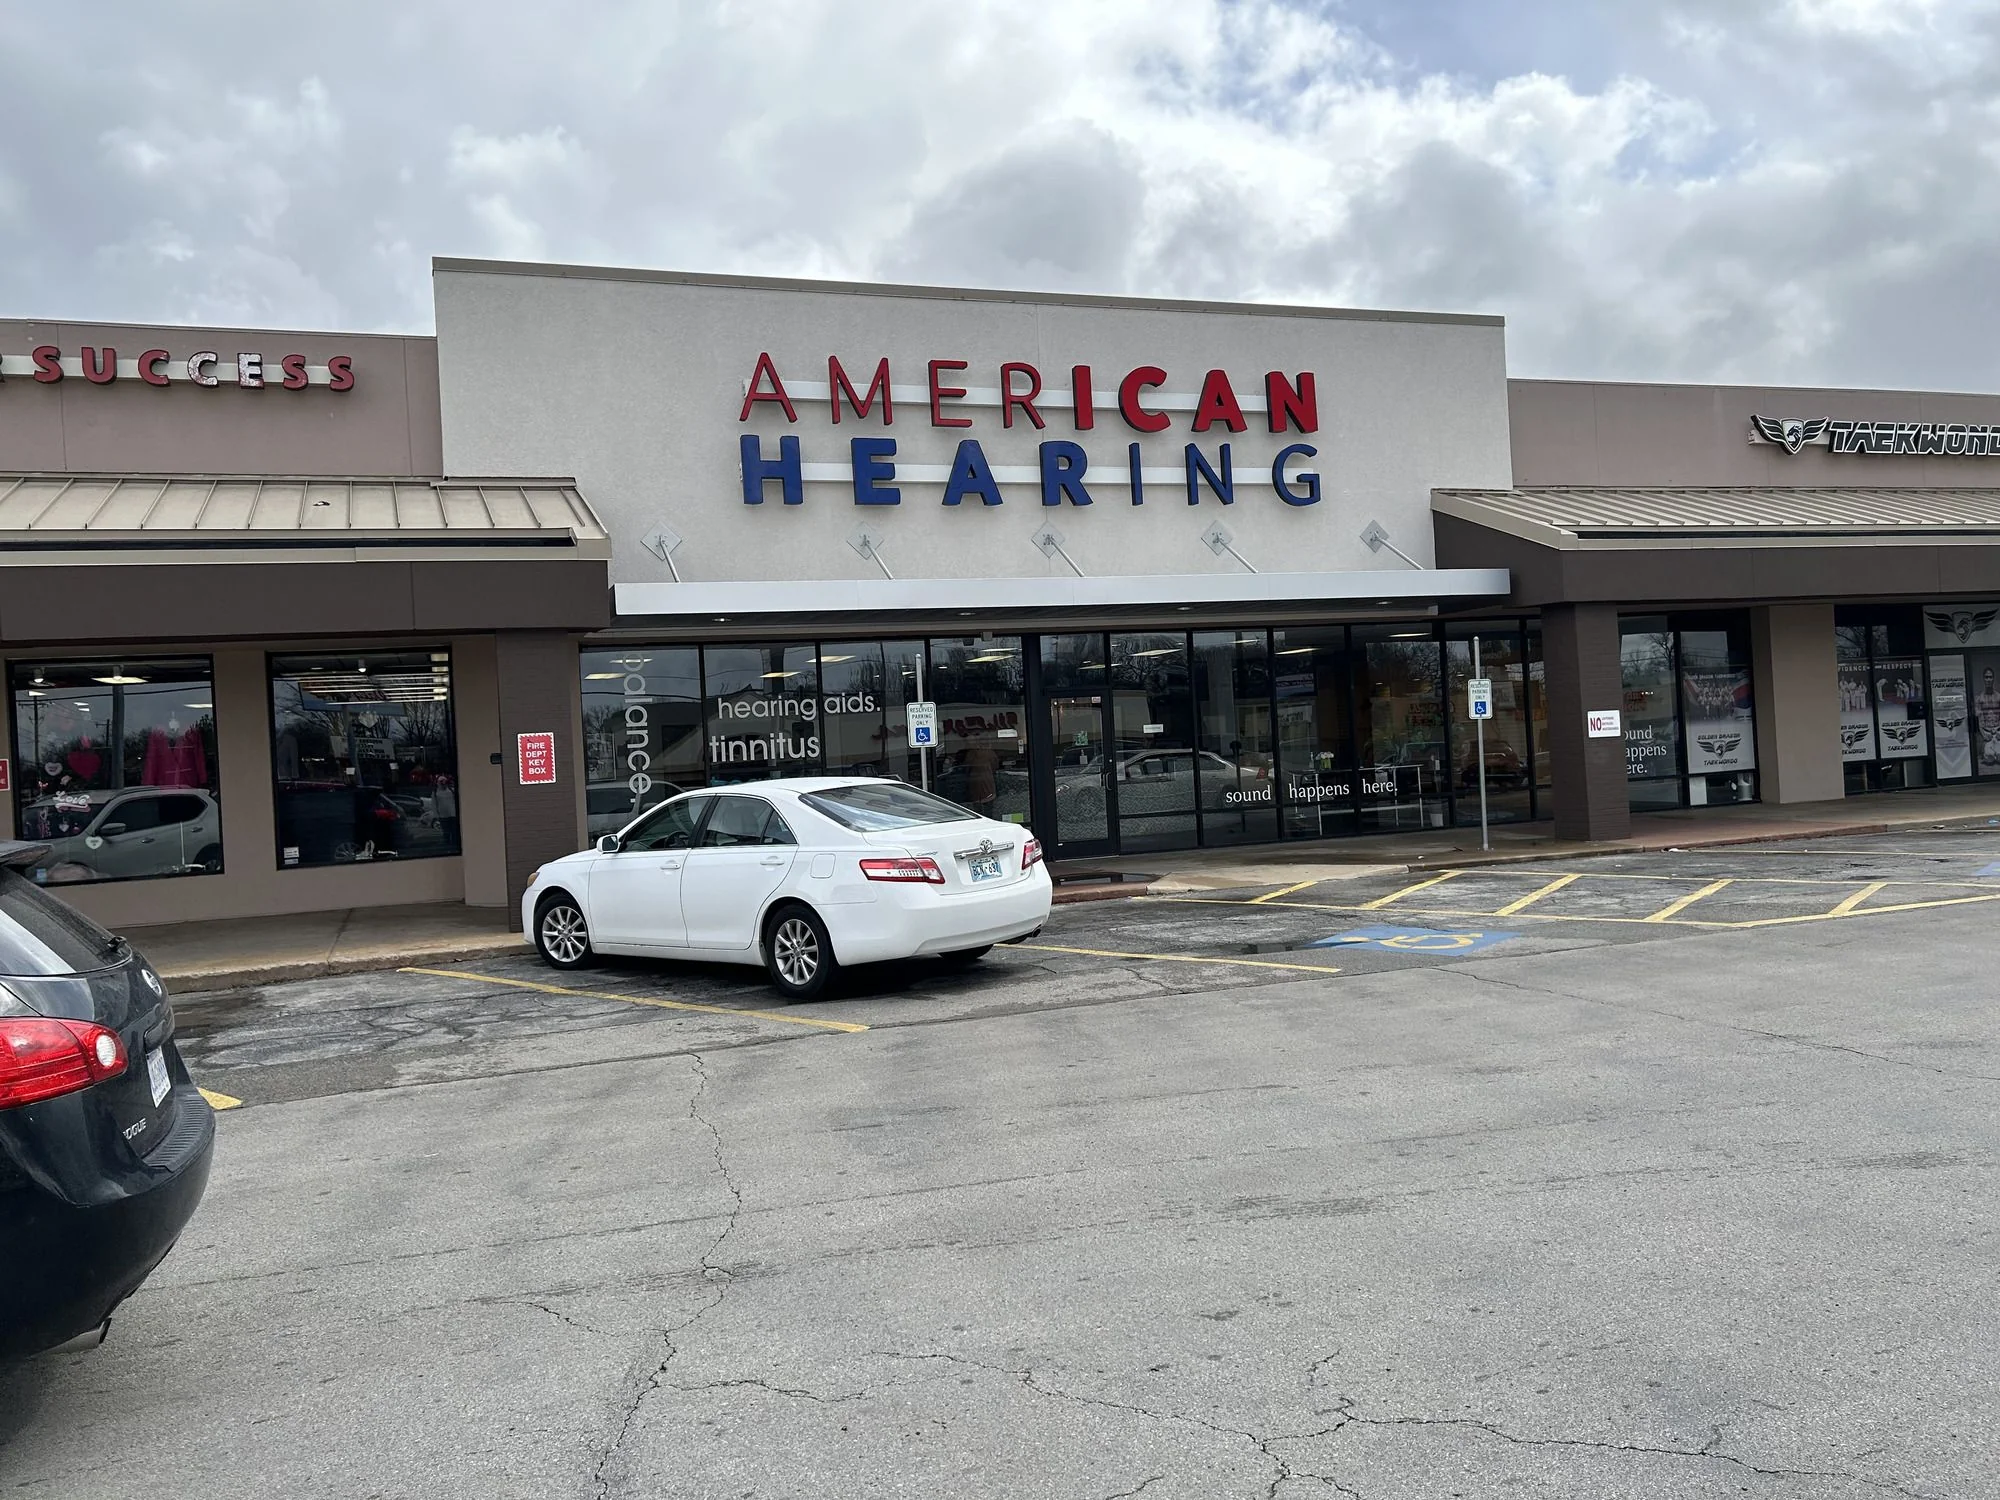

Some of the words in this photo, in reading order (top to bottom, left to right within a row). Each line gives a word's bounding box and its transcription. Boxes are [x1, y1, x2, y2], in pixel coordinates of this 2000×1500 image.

[31, 345, 356, 392] SUCCESS
[739, 352, 1319, 434] AMERICAN
[739, 434, 1321, 507] HEARING
[718, 695, 817, 721] hearing
[824, 692, 881, 714] aids.
[1590, 717, 1602, 732] NO
[525, 750, 547, 758] DEPT
[527, 742, 546, 750] FIRE
[709, 732, 821, 763] tinnitus
[528, 767, 547, 775] BOX
[1225, 785, 1272, 803] sound
[1288, 783, 1350, 803] happens
[1362, 778, 1399, 794] here.
